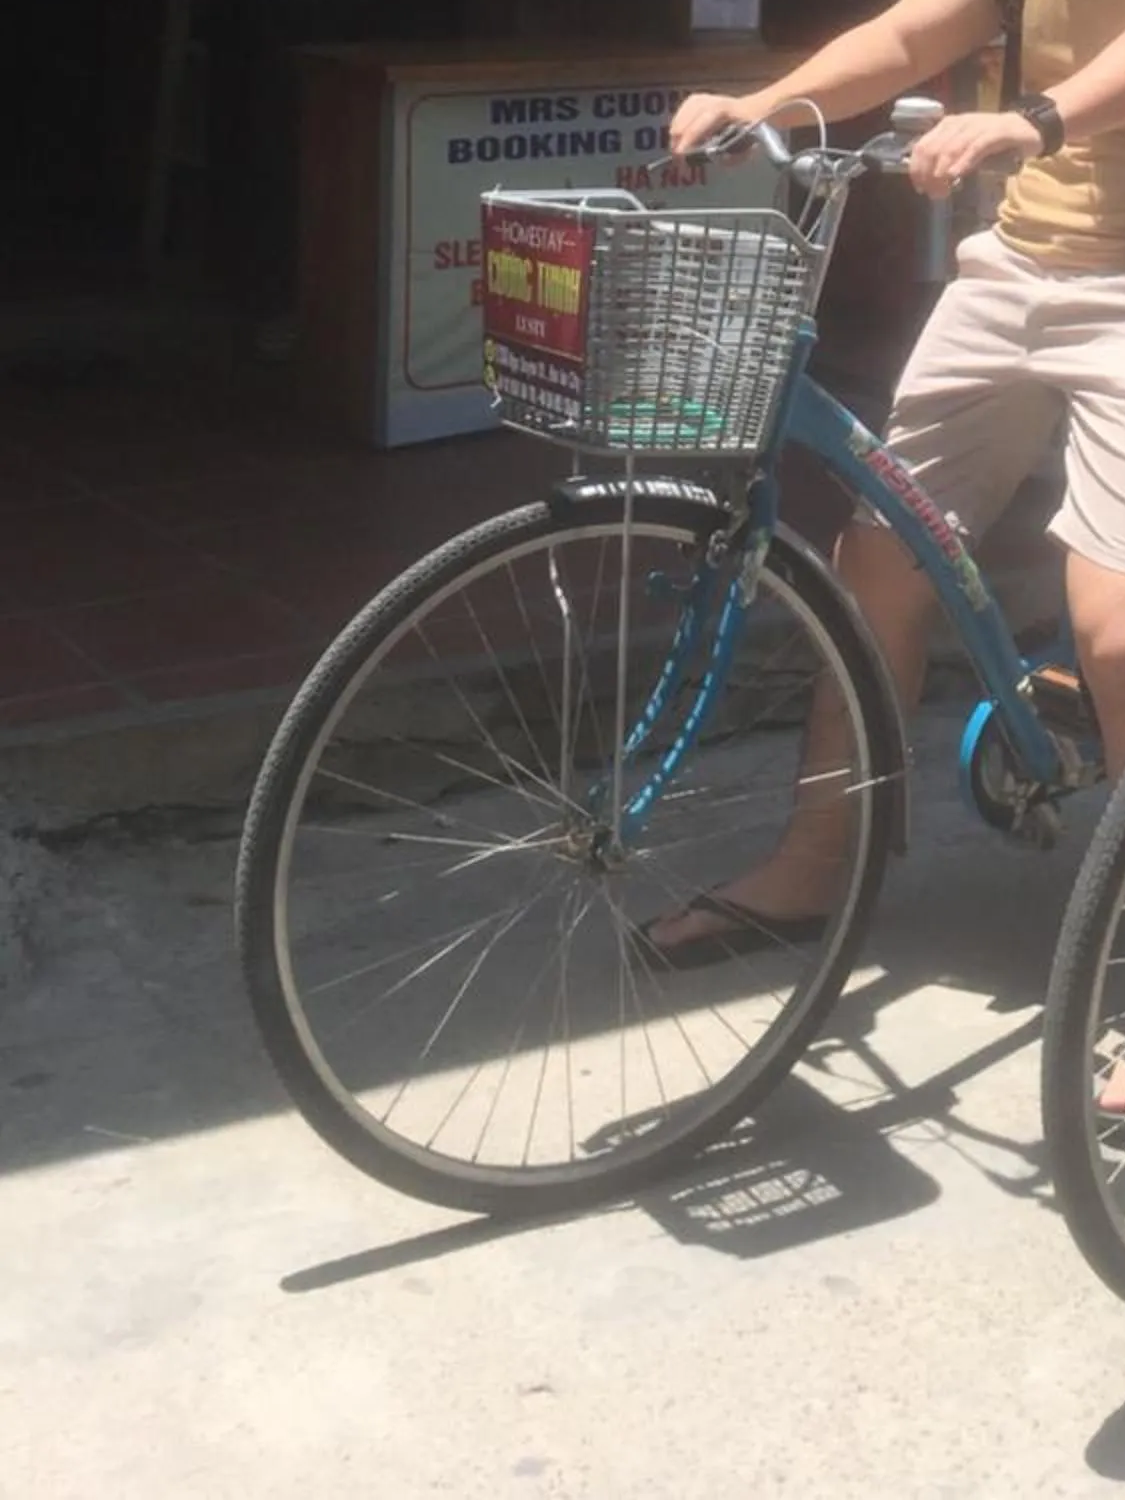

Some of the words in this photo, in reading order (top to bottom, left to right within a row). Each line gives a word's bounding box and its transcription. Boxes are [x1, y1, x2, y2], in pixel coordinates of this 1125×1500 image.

[491, 96, 579, 126] MRS
[593, 91, 683, 119] CUO
[448, 129, 621, 164] BOOKING
[502, 219, 565, 252] HOMESTAY
